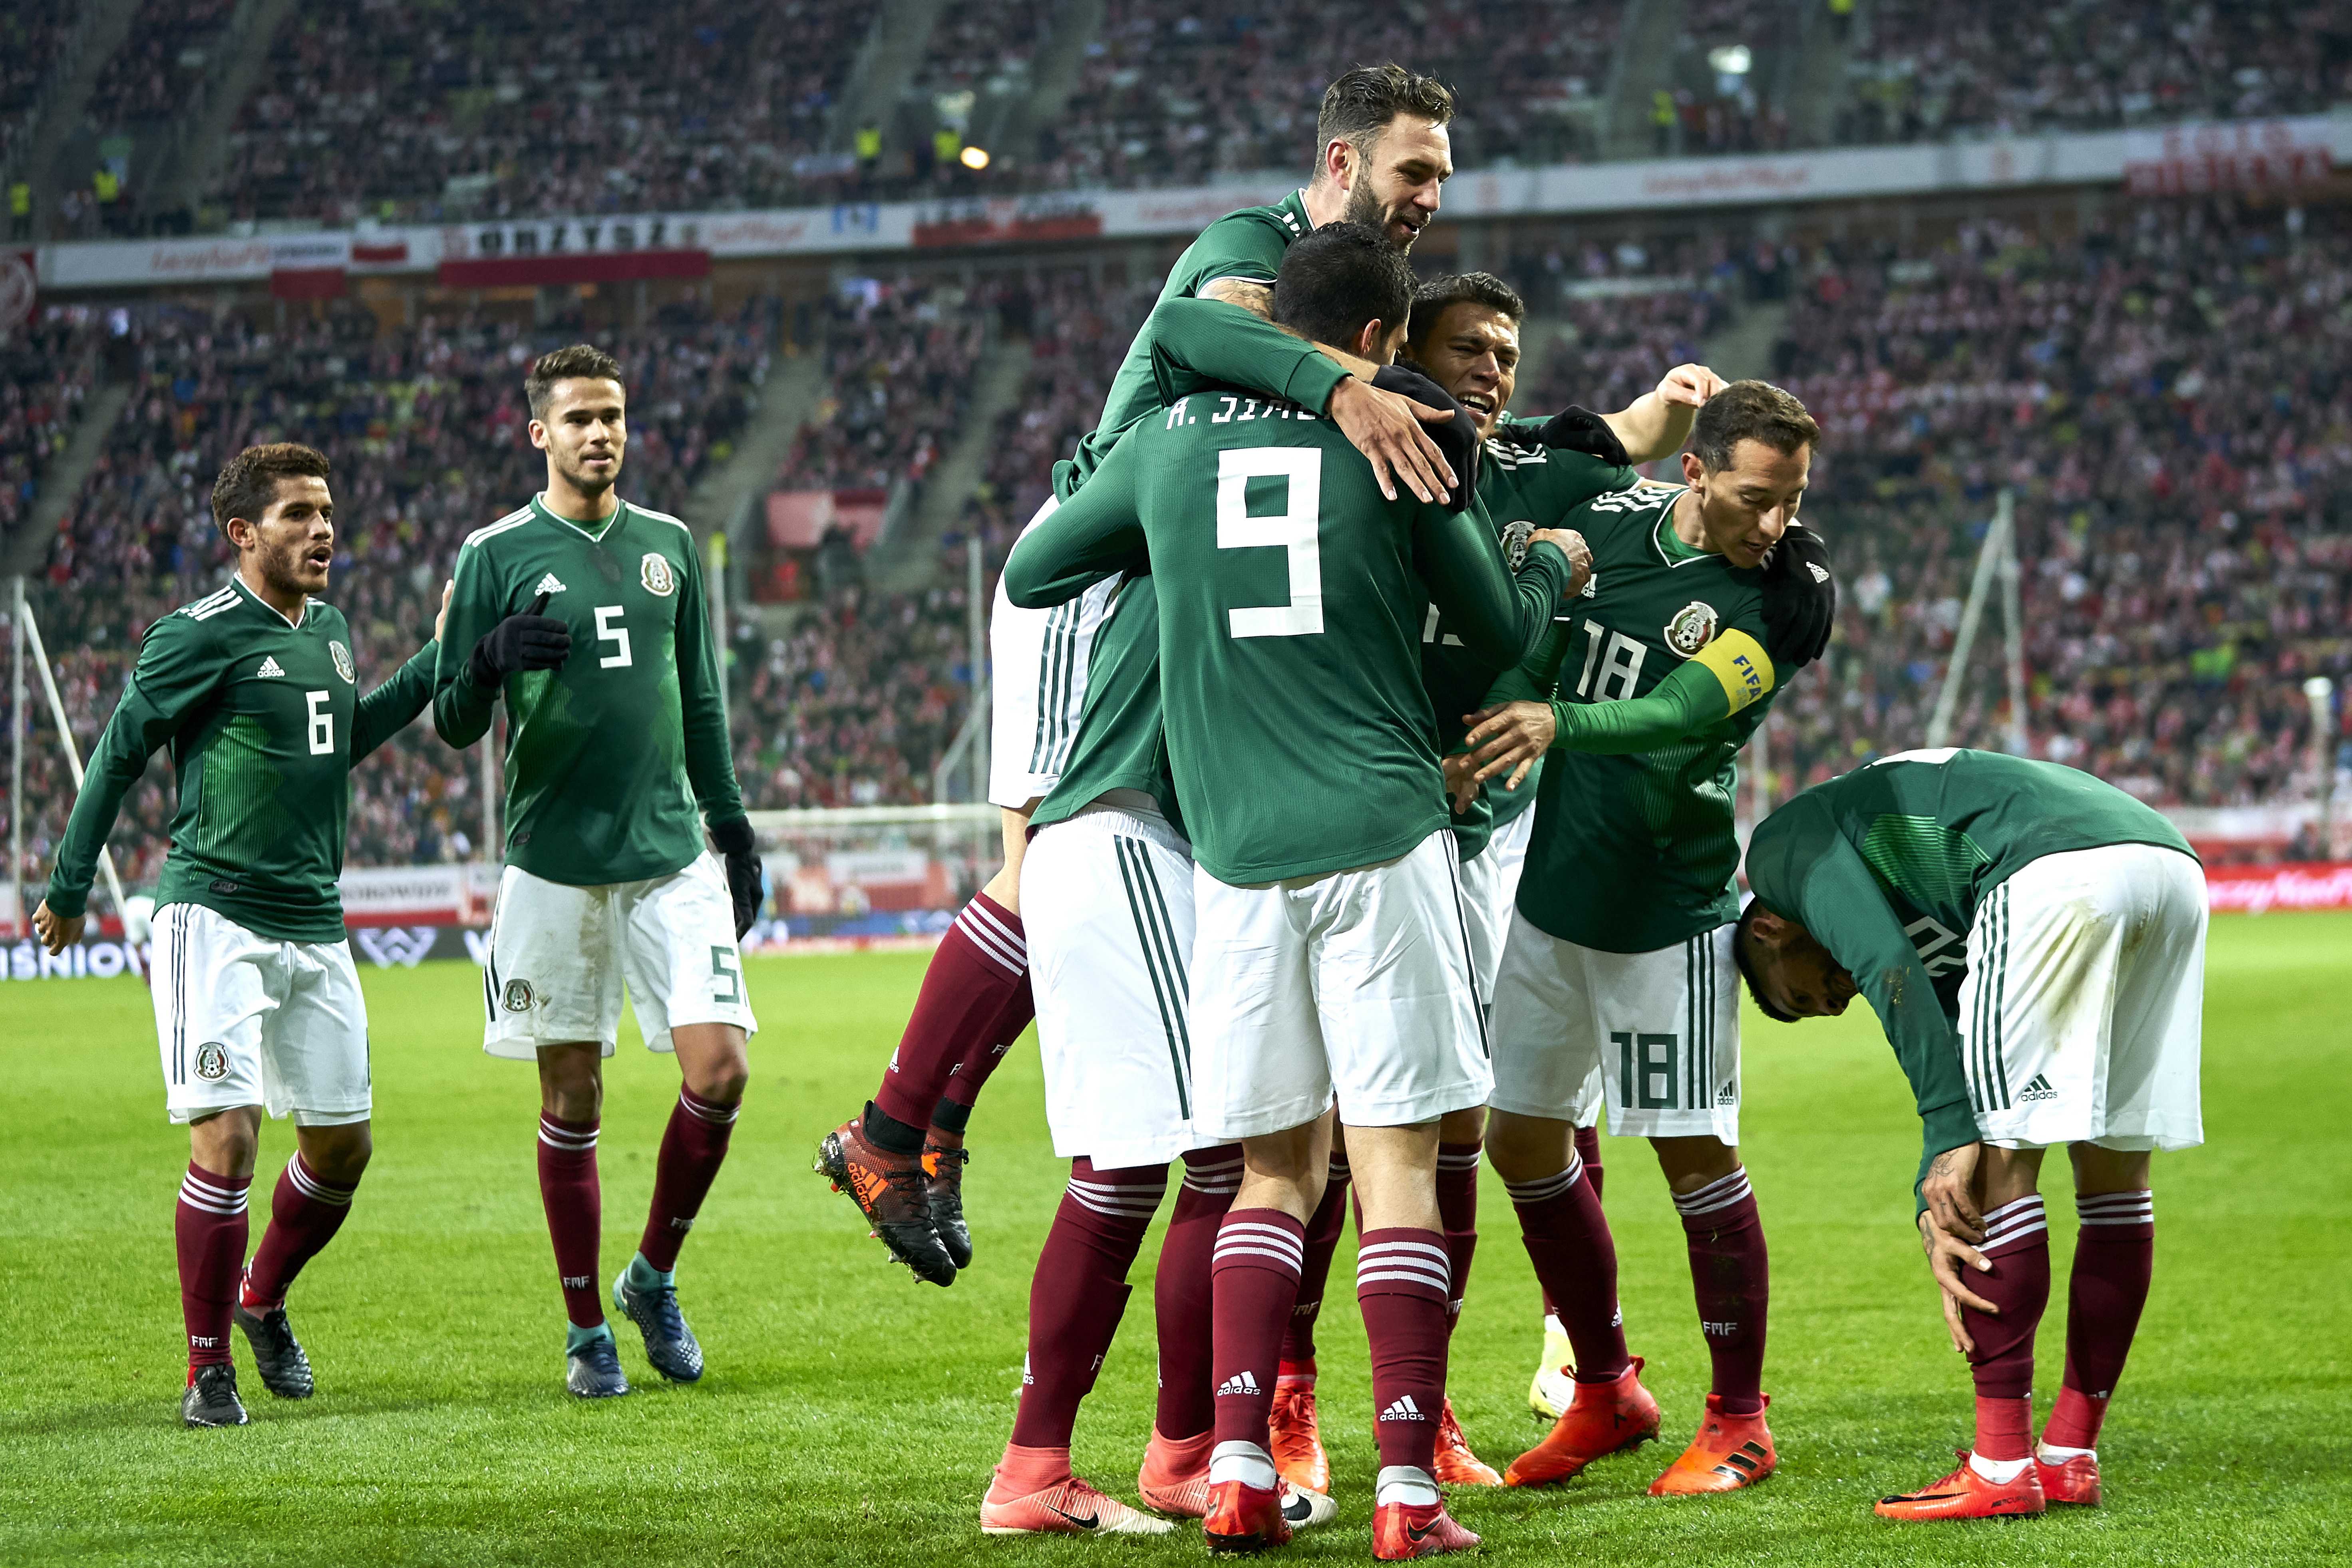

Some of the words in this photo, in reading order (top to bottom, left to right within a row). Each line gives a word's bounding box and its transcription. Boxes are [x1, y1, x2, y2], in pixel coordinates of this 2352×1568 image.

[1211, 397, 1330, 423] JIME
[1217, 447, 1325, 639] 9
[594, 605, 632, 669] 5
[257, 668, 285, 678] adidas
[1577, 618, 1648, 702] 18
[1732, 654, 1762, 702] FIFA
[306, 690, 334, 755] 6
[711, 945, 740, 1004] 5
[1610, 1031, 1678, 1109] 18
[1717, 1096, 1734, 1105] adidas
[2021, 1090, 2058, 1101] adidas
[848, 1162, 872, 1213] adidas
[563, 1275, 590, 1290] FMF
[191, 1335, 219, 1348] FMF
[1703, 1321, 1738, 1337] FMF
[1217, 1385, 1261, 1397] adidas
[1380, 1411, 1425, 1421] adidas
